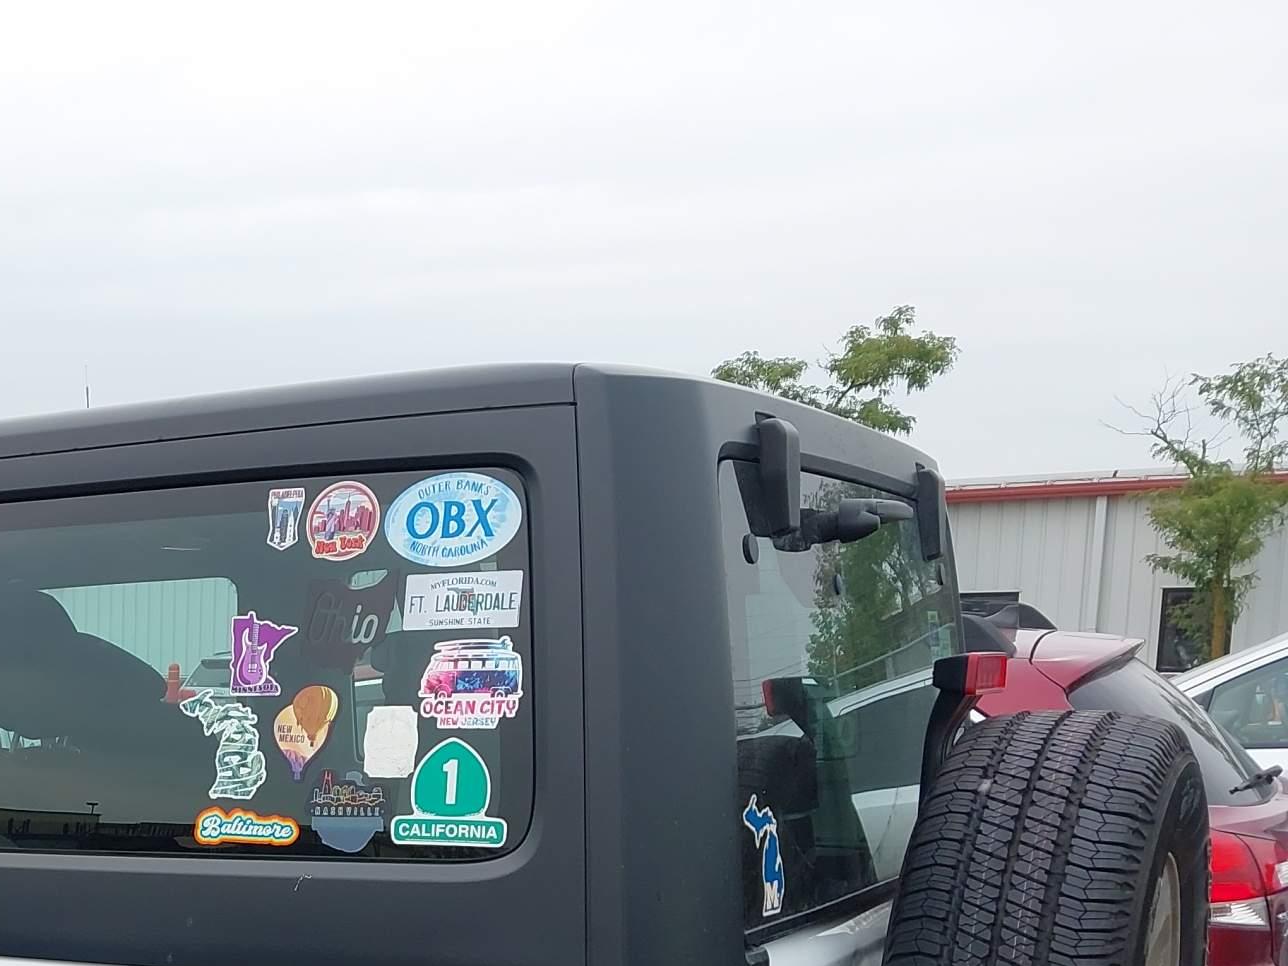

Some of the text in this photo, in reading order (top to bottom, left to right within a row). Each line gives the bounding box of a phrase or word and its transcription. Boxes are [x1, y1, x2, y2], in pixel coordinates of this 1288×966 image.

[418, 480, 492, 499] OUTER BANKS
[406, 499, 498, 539] OBX
[410, 538, 488, 558] NORTH CAROLINA
[409, 592, 519, 614] FT. LAUDERDALE
[428, 617, 491, 627] SUNSHINE STATE
[232, 683, 279, 694] MINNESOTA
[422, 700, 517, 716] OCEAN CITY
[277, 724, 293, 734] NEW
[439, 716, 497, 727] NEW JERSEY
[278, 733, 305, 743] MEXICO
[442, 758, 459, 805] 1
[315, 806, 380, 816] NASHVILLE
[200, 815, 293, 839] Baltimore
[398, 822, 498, 839] CALIFORNIA
